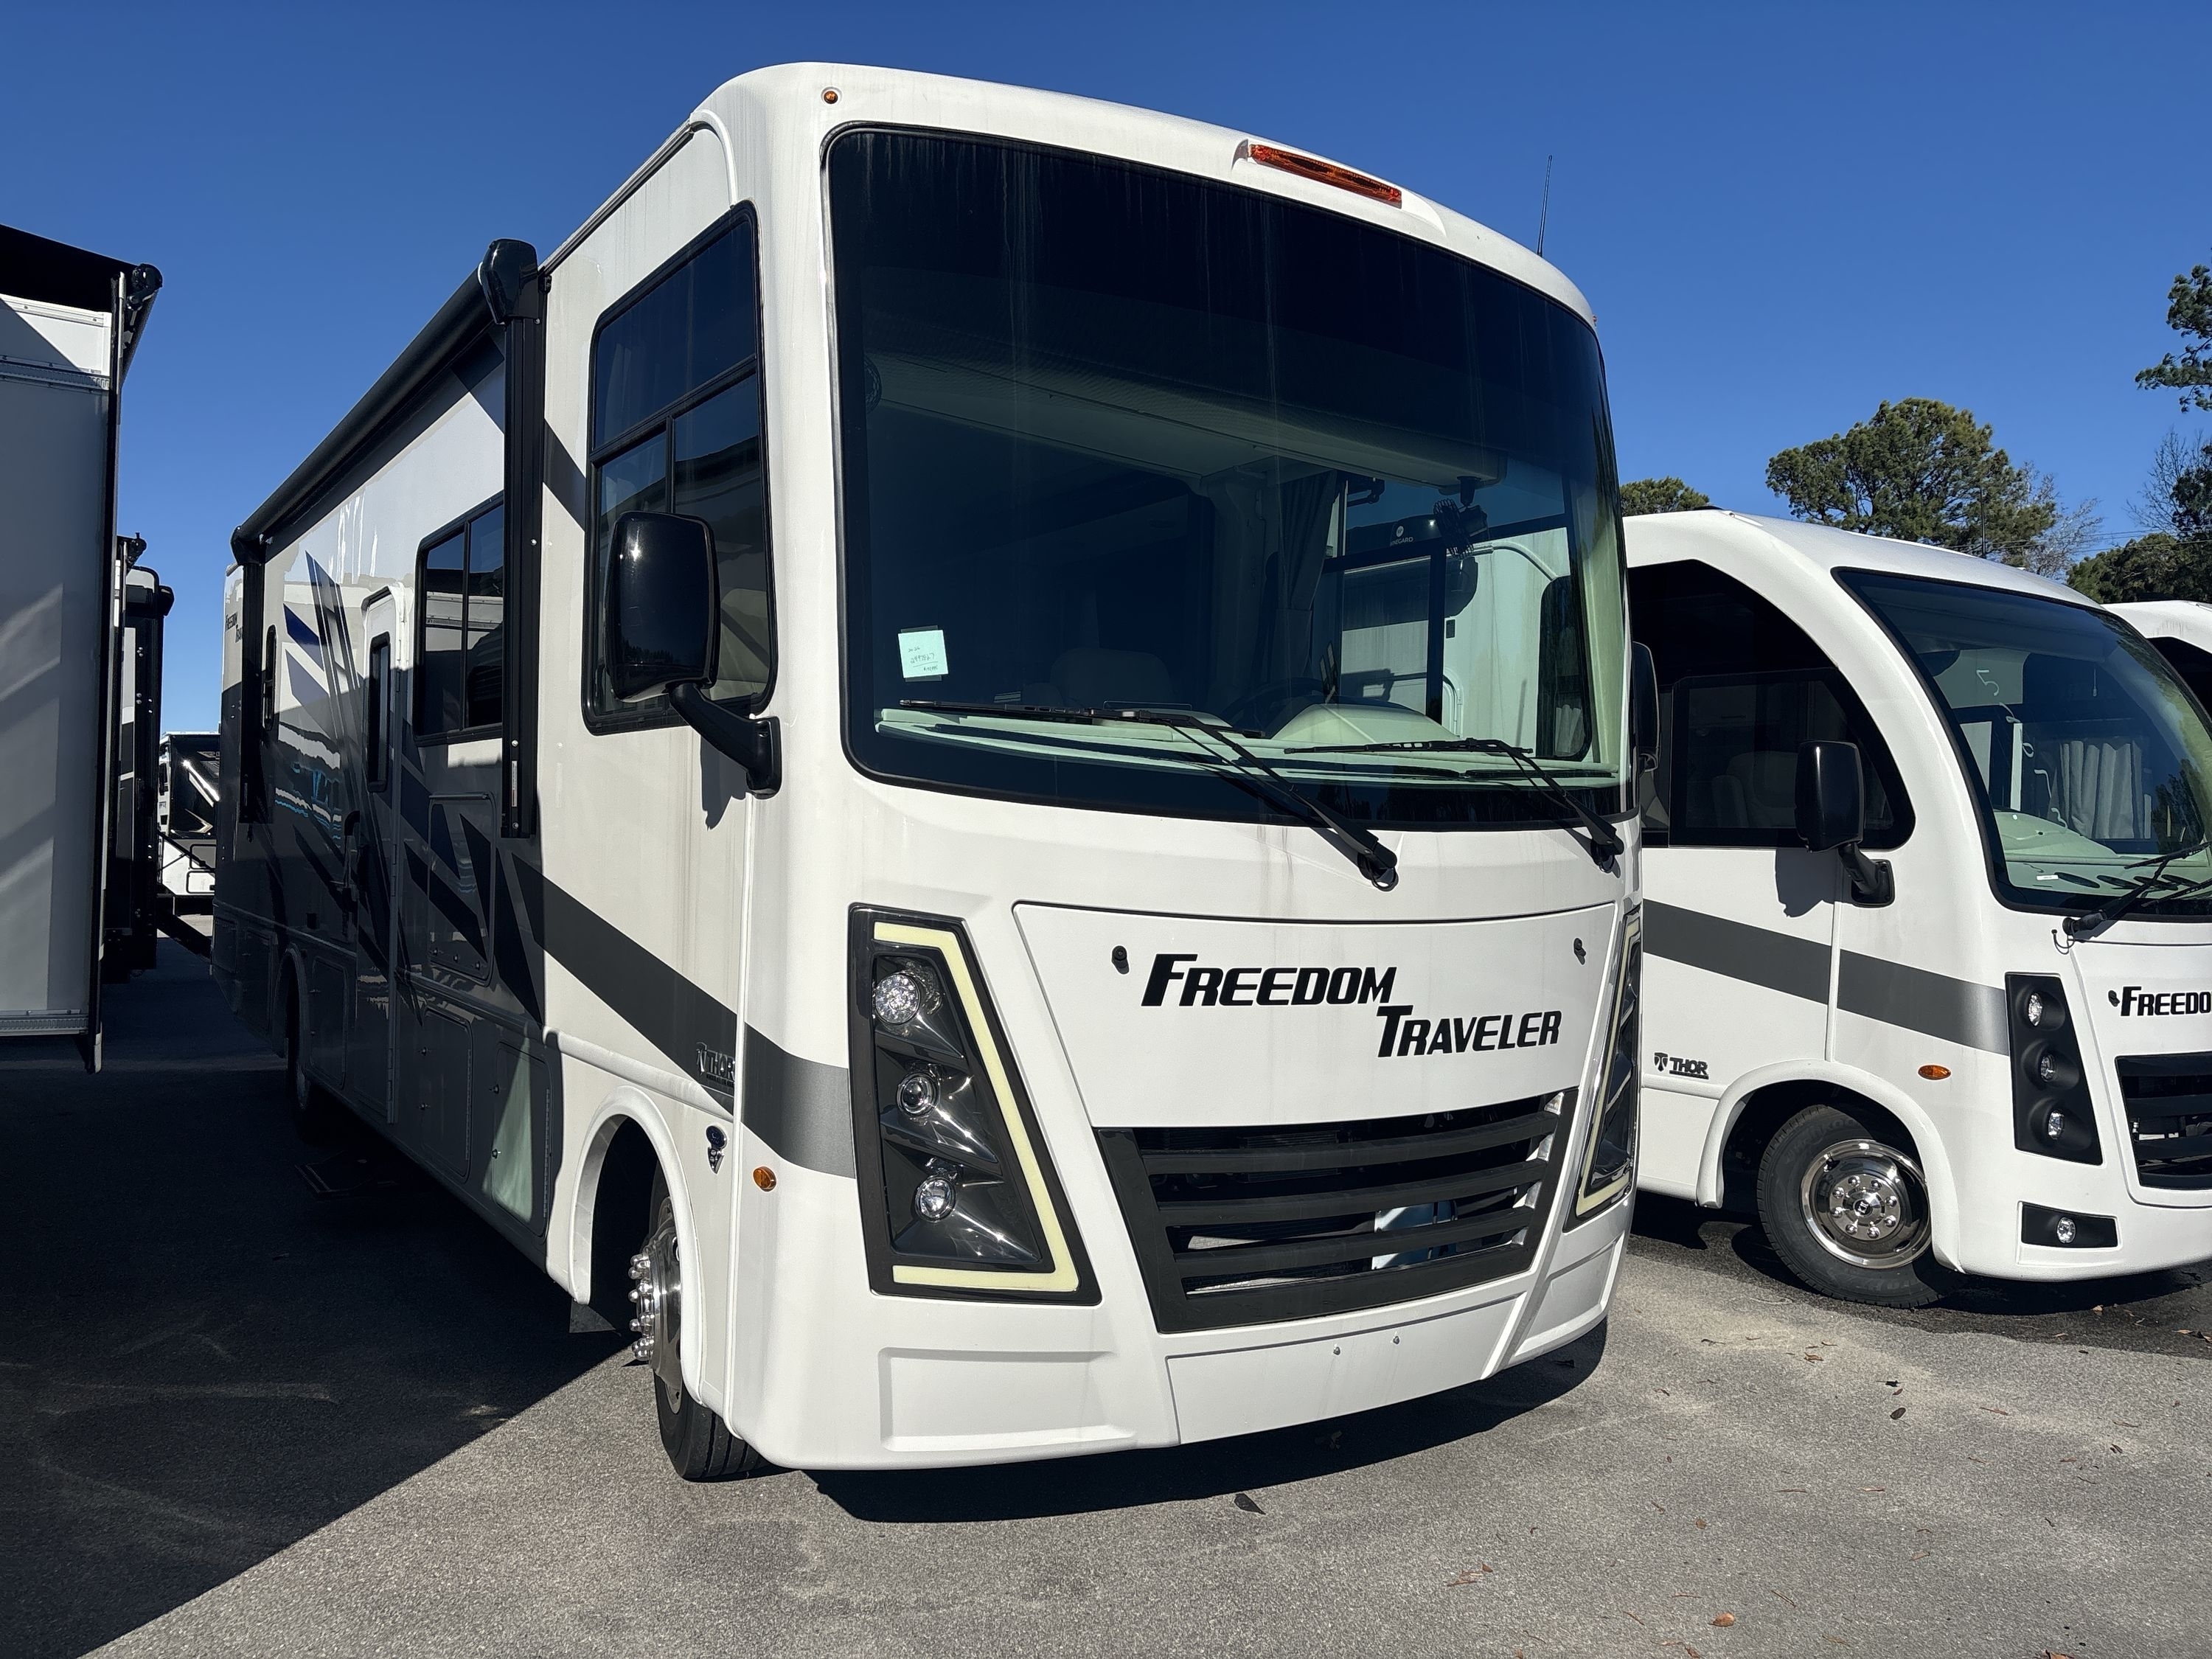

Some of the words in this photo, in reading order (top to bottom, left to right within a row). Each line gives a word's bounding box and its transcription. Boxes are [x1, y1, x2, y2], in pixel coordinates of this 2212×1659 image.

[1140, 953, 1397, 1006] FREEDOM
[2121, 986, 2212, 1017] FREEDO
[1377, 1005, 1562, 1057] TRAVELER
[706, 1048, 735, 1082] THOR
[1669, 1057, 1708, 1075] THOR
